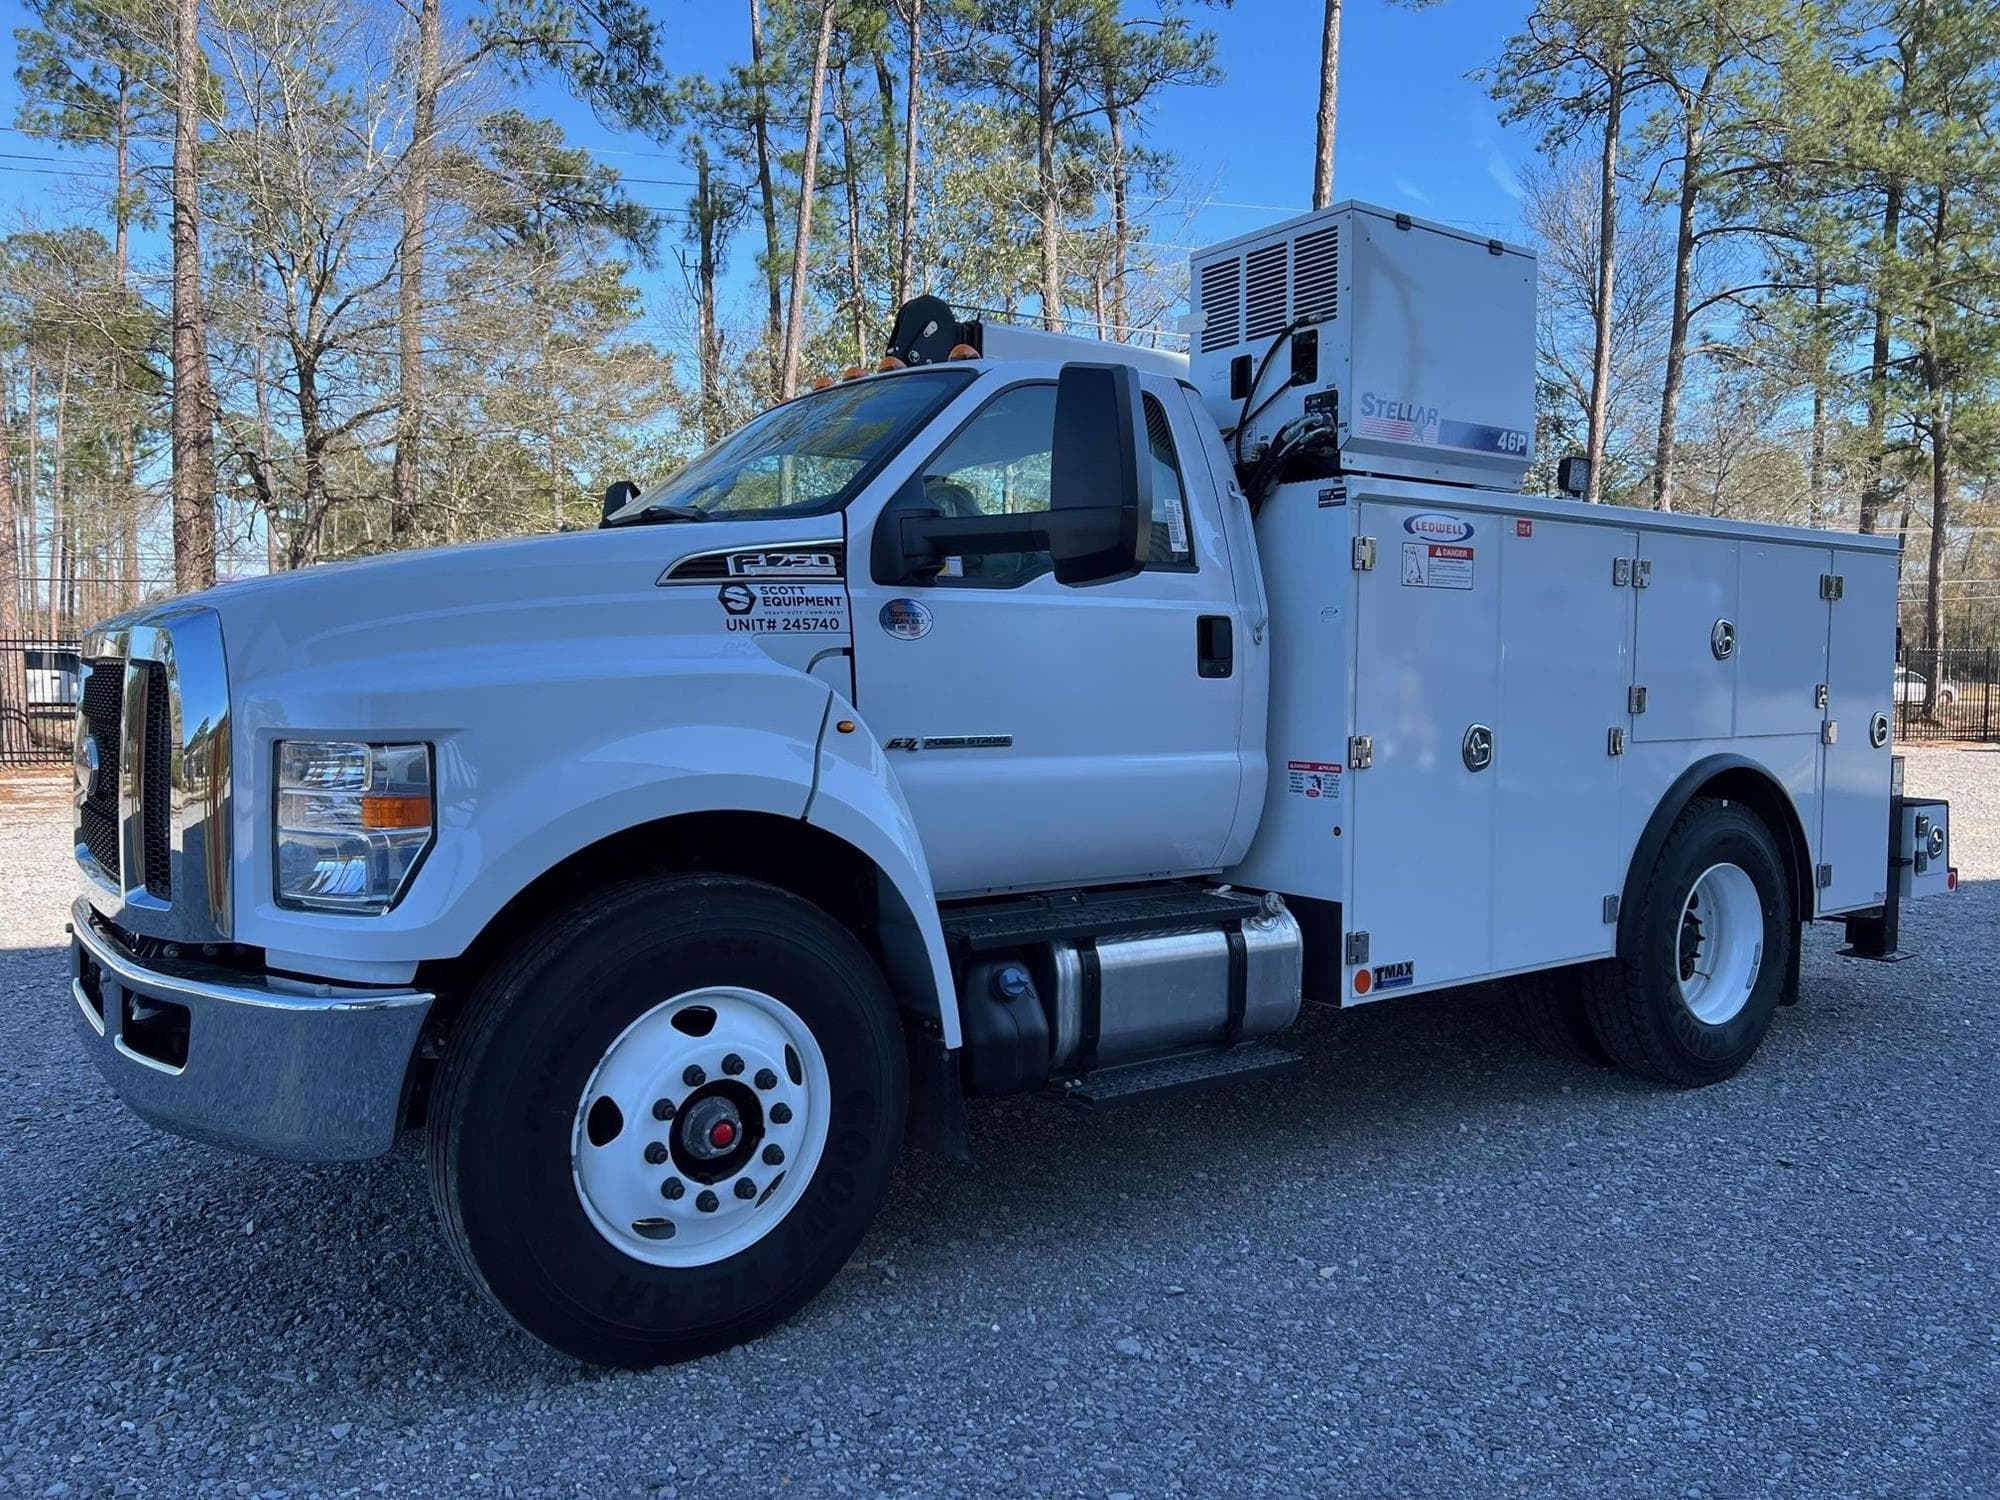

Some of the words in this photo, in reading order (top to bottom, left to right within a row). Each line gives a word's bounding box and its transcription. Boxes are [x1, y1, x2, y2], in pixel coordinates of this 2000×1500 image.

[1360, 391, 1439, 426] STELLAR
[1497, 431, 1527, 452] 46P
[1415, 521, 1464, 535] LEDWELL
[1442, 548, 1468, 558] DANGER
[760, 586, 805, 595] SCOTT
[763, 596, 842, 607] EQUIPMENT
[726, 618, 777, 632] UNIT#
[782, 617, 839, 631] 245740
[967, 736, 1012, 745] STROKE
[1374, 961, 1413, 989] TMAX
